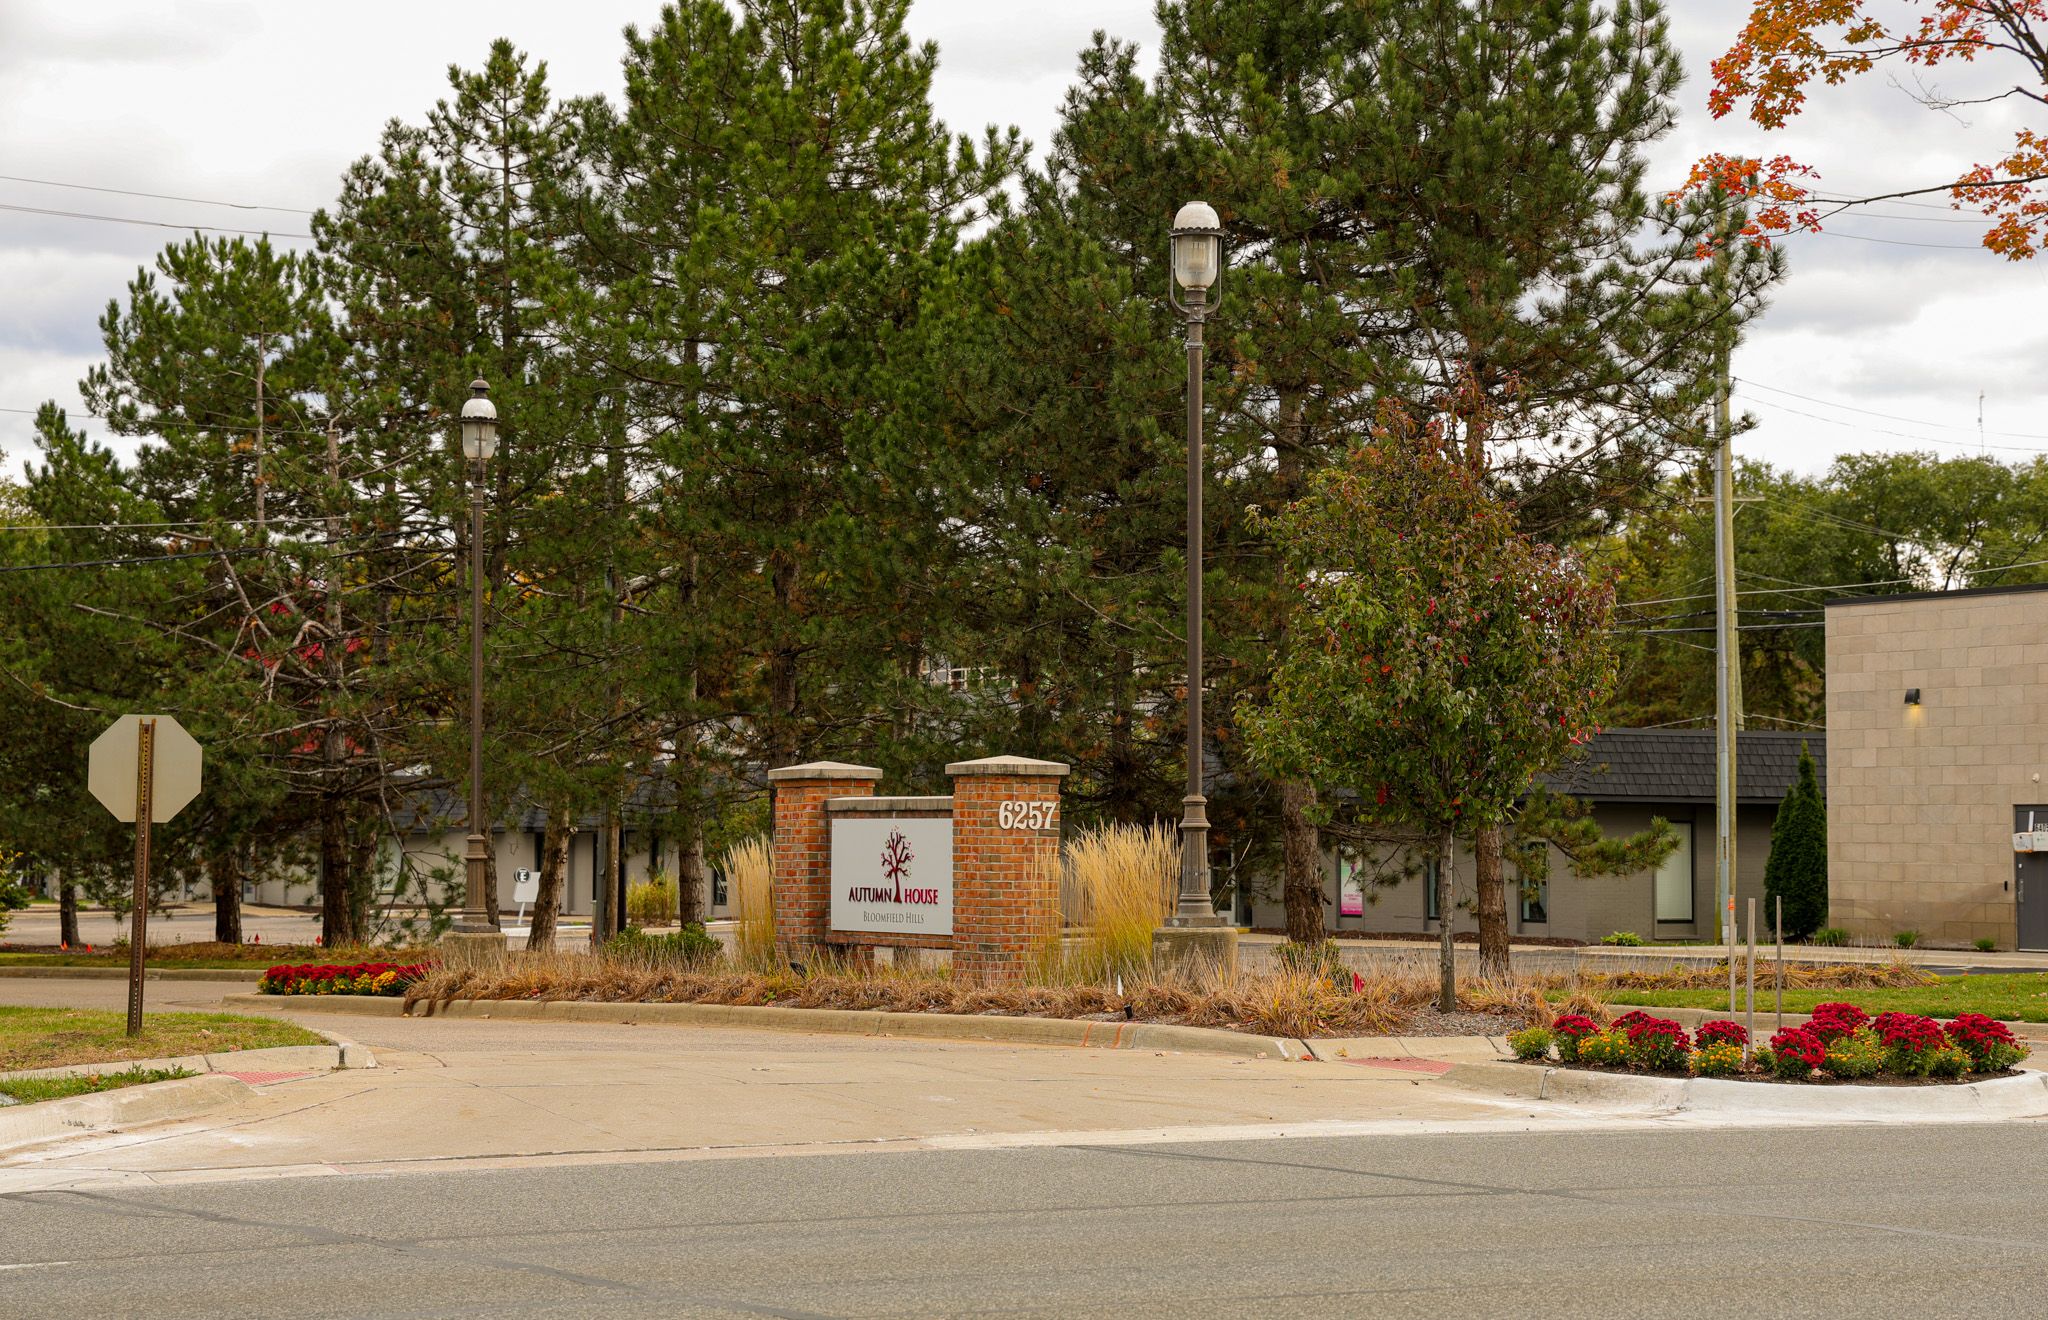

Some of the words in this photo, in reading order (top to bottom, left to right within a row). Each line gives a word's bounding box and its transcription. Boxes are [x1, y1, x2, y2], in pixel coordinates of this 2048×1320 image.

[999, 801, 1057, 830] 6257
[849, 887, 892, 903] AUTUMN
[904, 888, 938, 904] HOUSE
[863, 911, 904, 923] BLOOMFIELD
[906, 912, 924, 924] HILLS
